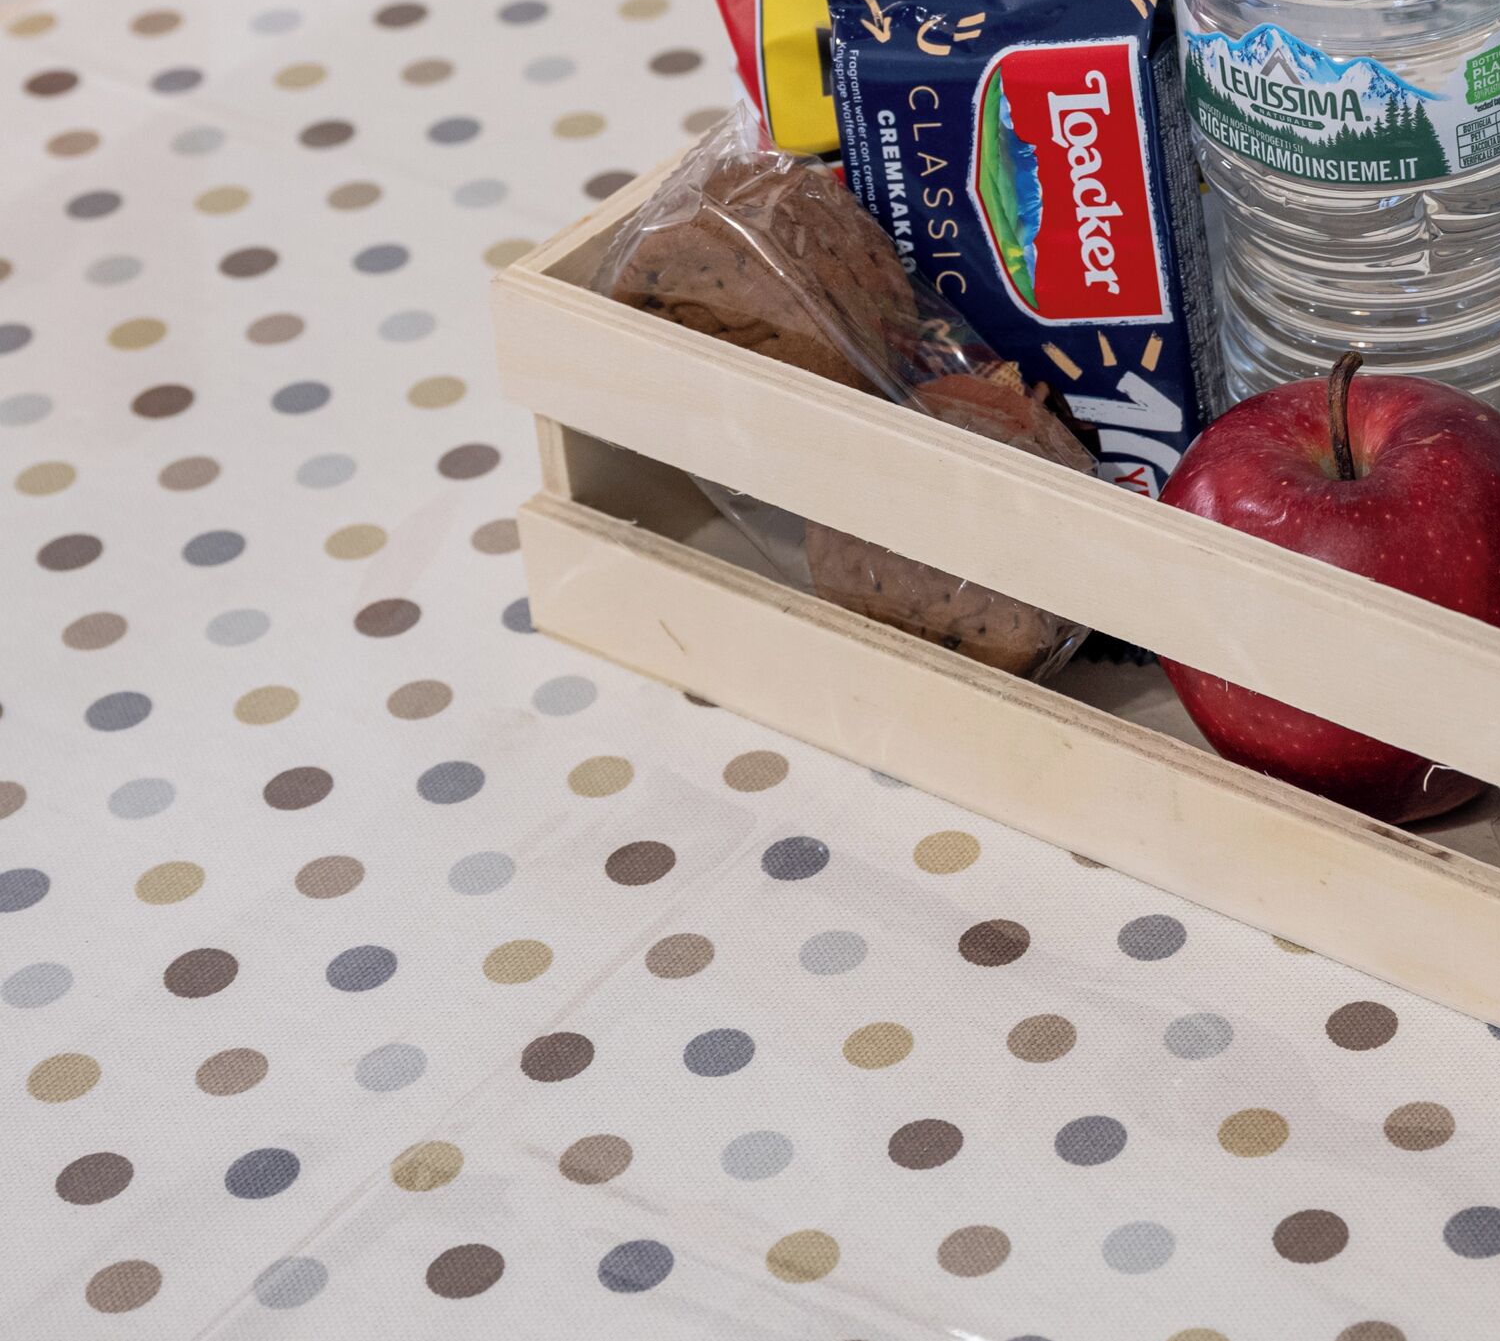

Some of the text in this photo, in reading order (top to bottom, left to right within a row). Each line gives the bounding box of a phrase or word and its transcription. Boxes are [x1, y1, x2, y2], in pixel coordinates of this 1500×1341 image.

[847, 49, 859, 103] Fragranti
[1219, 56, 1364, 122] LEVISSIMA
[842, 101, 856, 146] Waffeln
[849, 147, 857, 165] mit
[855, 105, 867, 139] wafer
[1199, 106, 1419, 182] RIGENERIAMOINSIEME.IT
[1230, 117, 1255, 136] NOSTRI
[1256, 129, 1292, 151] PROGETTI
[1293, 144, 1304, 154] SU
[1259, 109, 1315, 129] NATURALE
[860, 142, 871, 161] con
[863, 164, 876, 201] crema
[877, 109, 917, 273] CREMKAKAO
[908, 85, 967, 295] CLASSIC
[1046, 69, 1121, 296] Loacker
